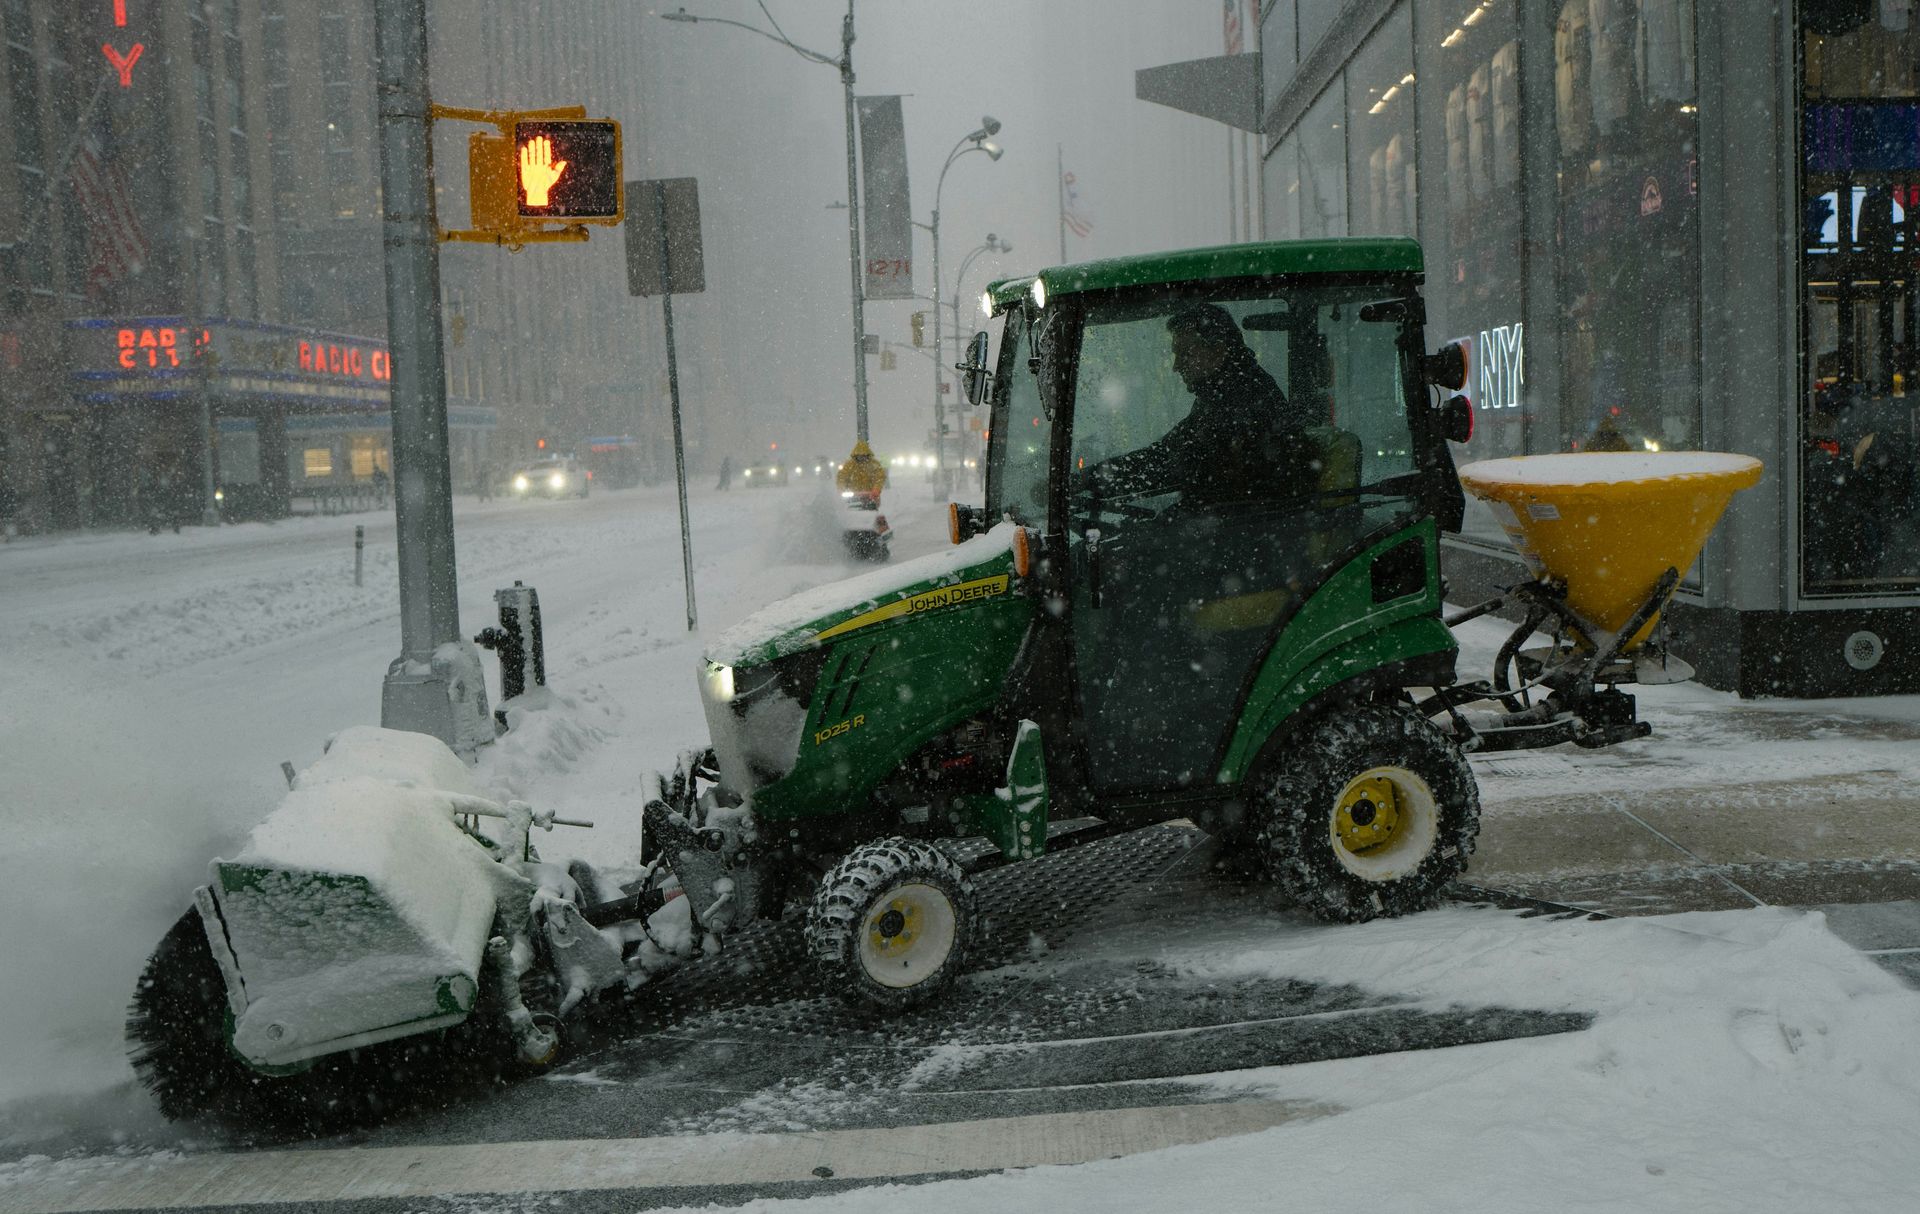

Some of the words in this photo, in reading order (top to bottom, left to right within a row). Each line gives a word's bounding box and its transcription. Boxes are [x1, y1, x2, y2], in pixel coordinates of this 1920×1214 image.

[298, 341, 363, 377] RADIO
[905, 592, 948, 613] JOHN
[951, 582, 1002, 602] DEERE
